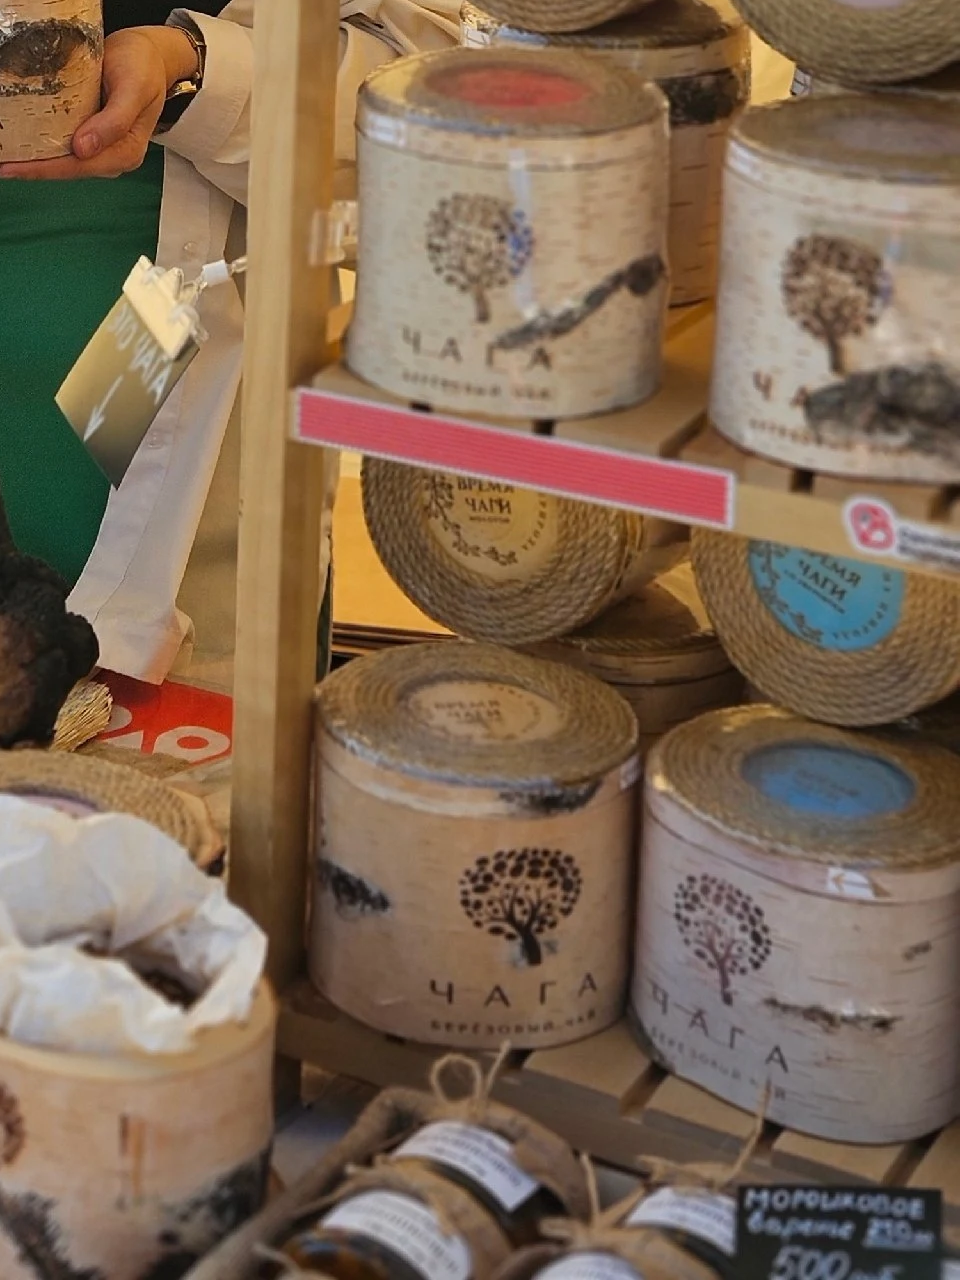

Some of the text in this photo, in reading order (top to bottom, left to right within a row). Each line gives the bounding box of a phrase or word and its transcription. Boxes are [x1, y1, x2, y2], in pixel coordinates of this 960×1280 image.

[402, 324, 553, 372] ЧАГА
[464, 496, 513, 516] ЧАГИ
[797, 558, 848, 603] ЧАГИ
[429, 972, 598, 1009] ЧАГА
[651, 984, 790, 1074] ЧАГА
